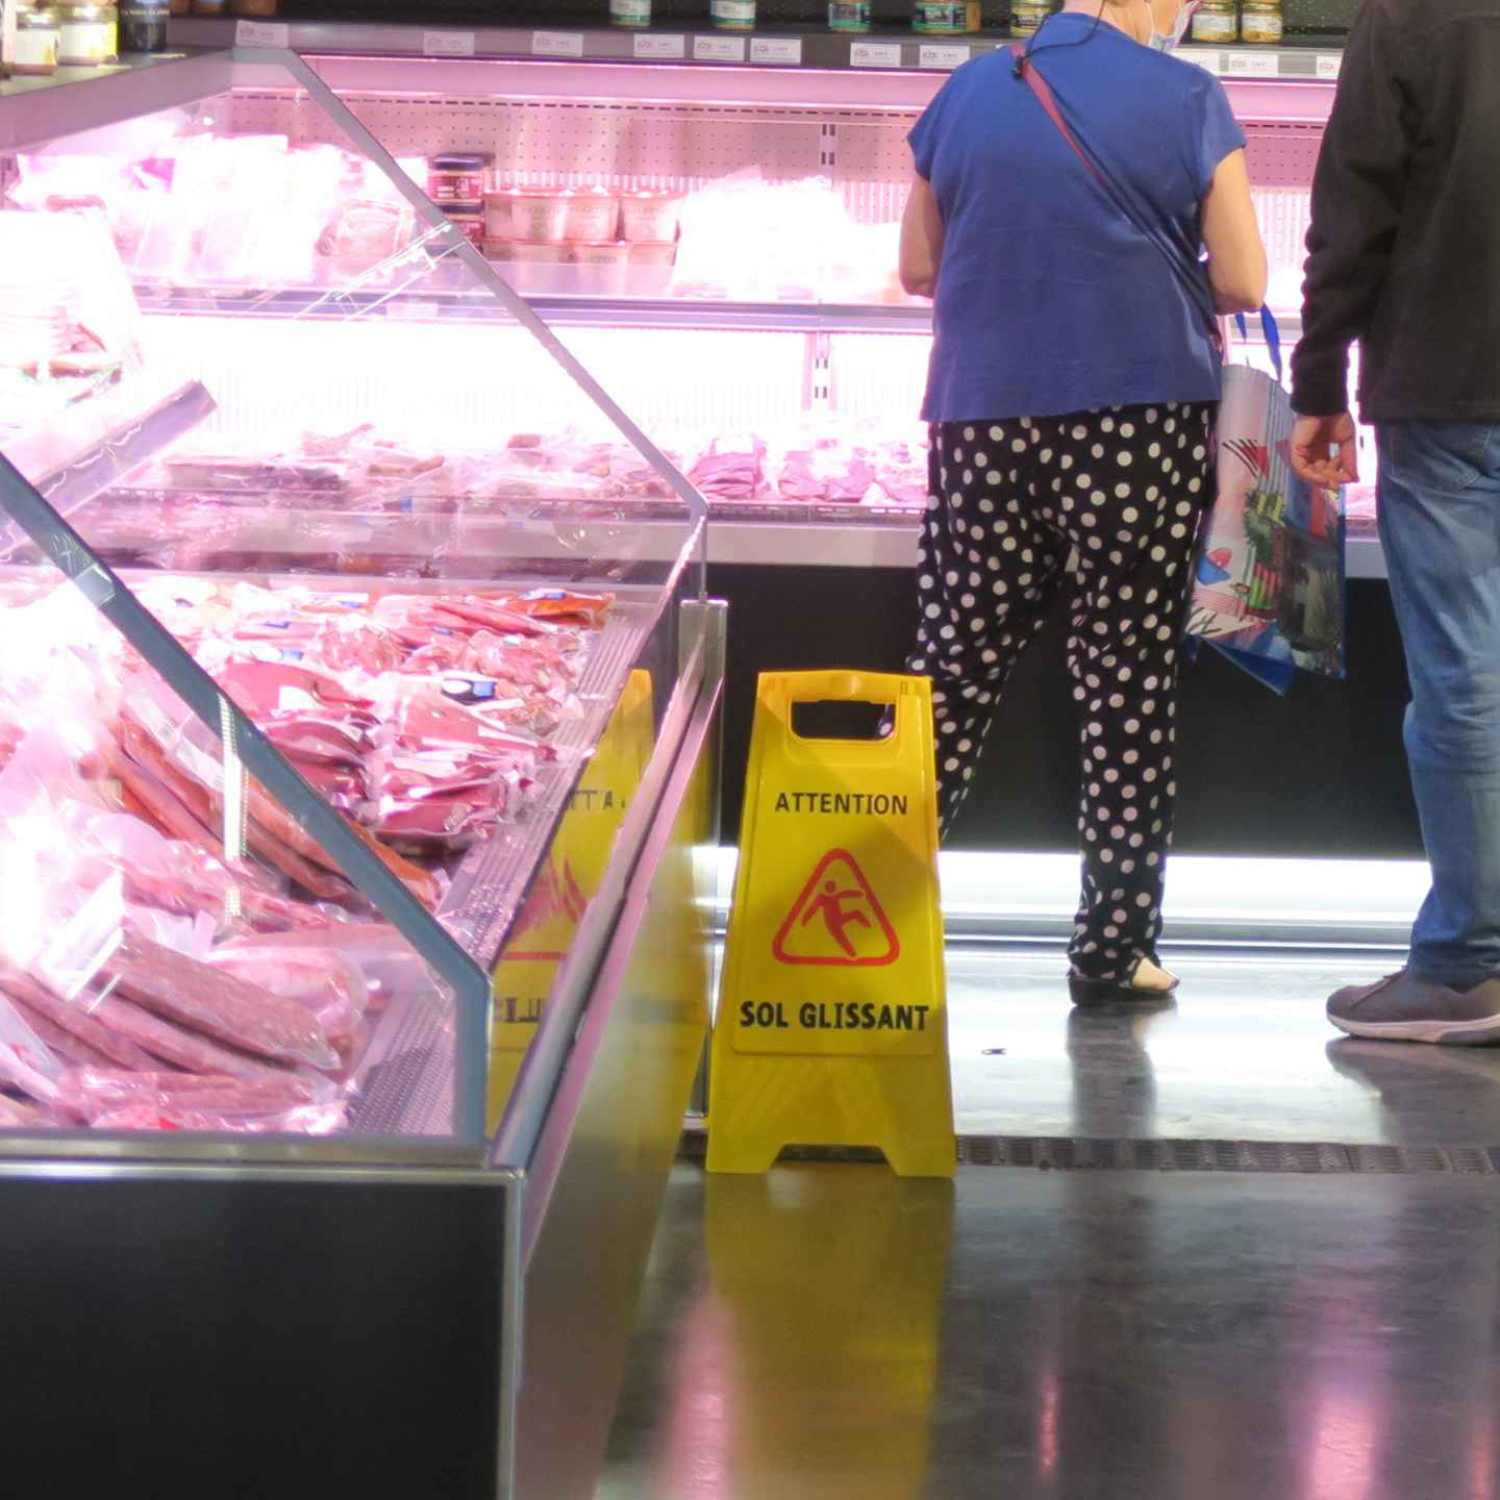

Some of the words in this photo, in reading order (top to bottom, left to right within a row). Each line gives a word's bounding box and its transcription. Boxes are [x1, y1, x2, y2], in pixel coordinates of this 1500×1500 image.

[774, 792, 908, 815] ATTENTION
[739, 1000, 789, 1028] SOL
[799, 1002, 930, 1031] GLISSANT
